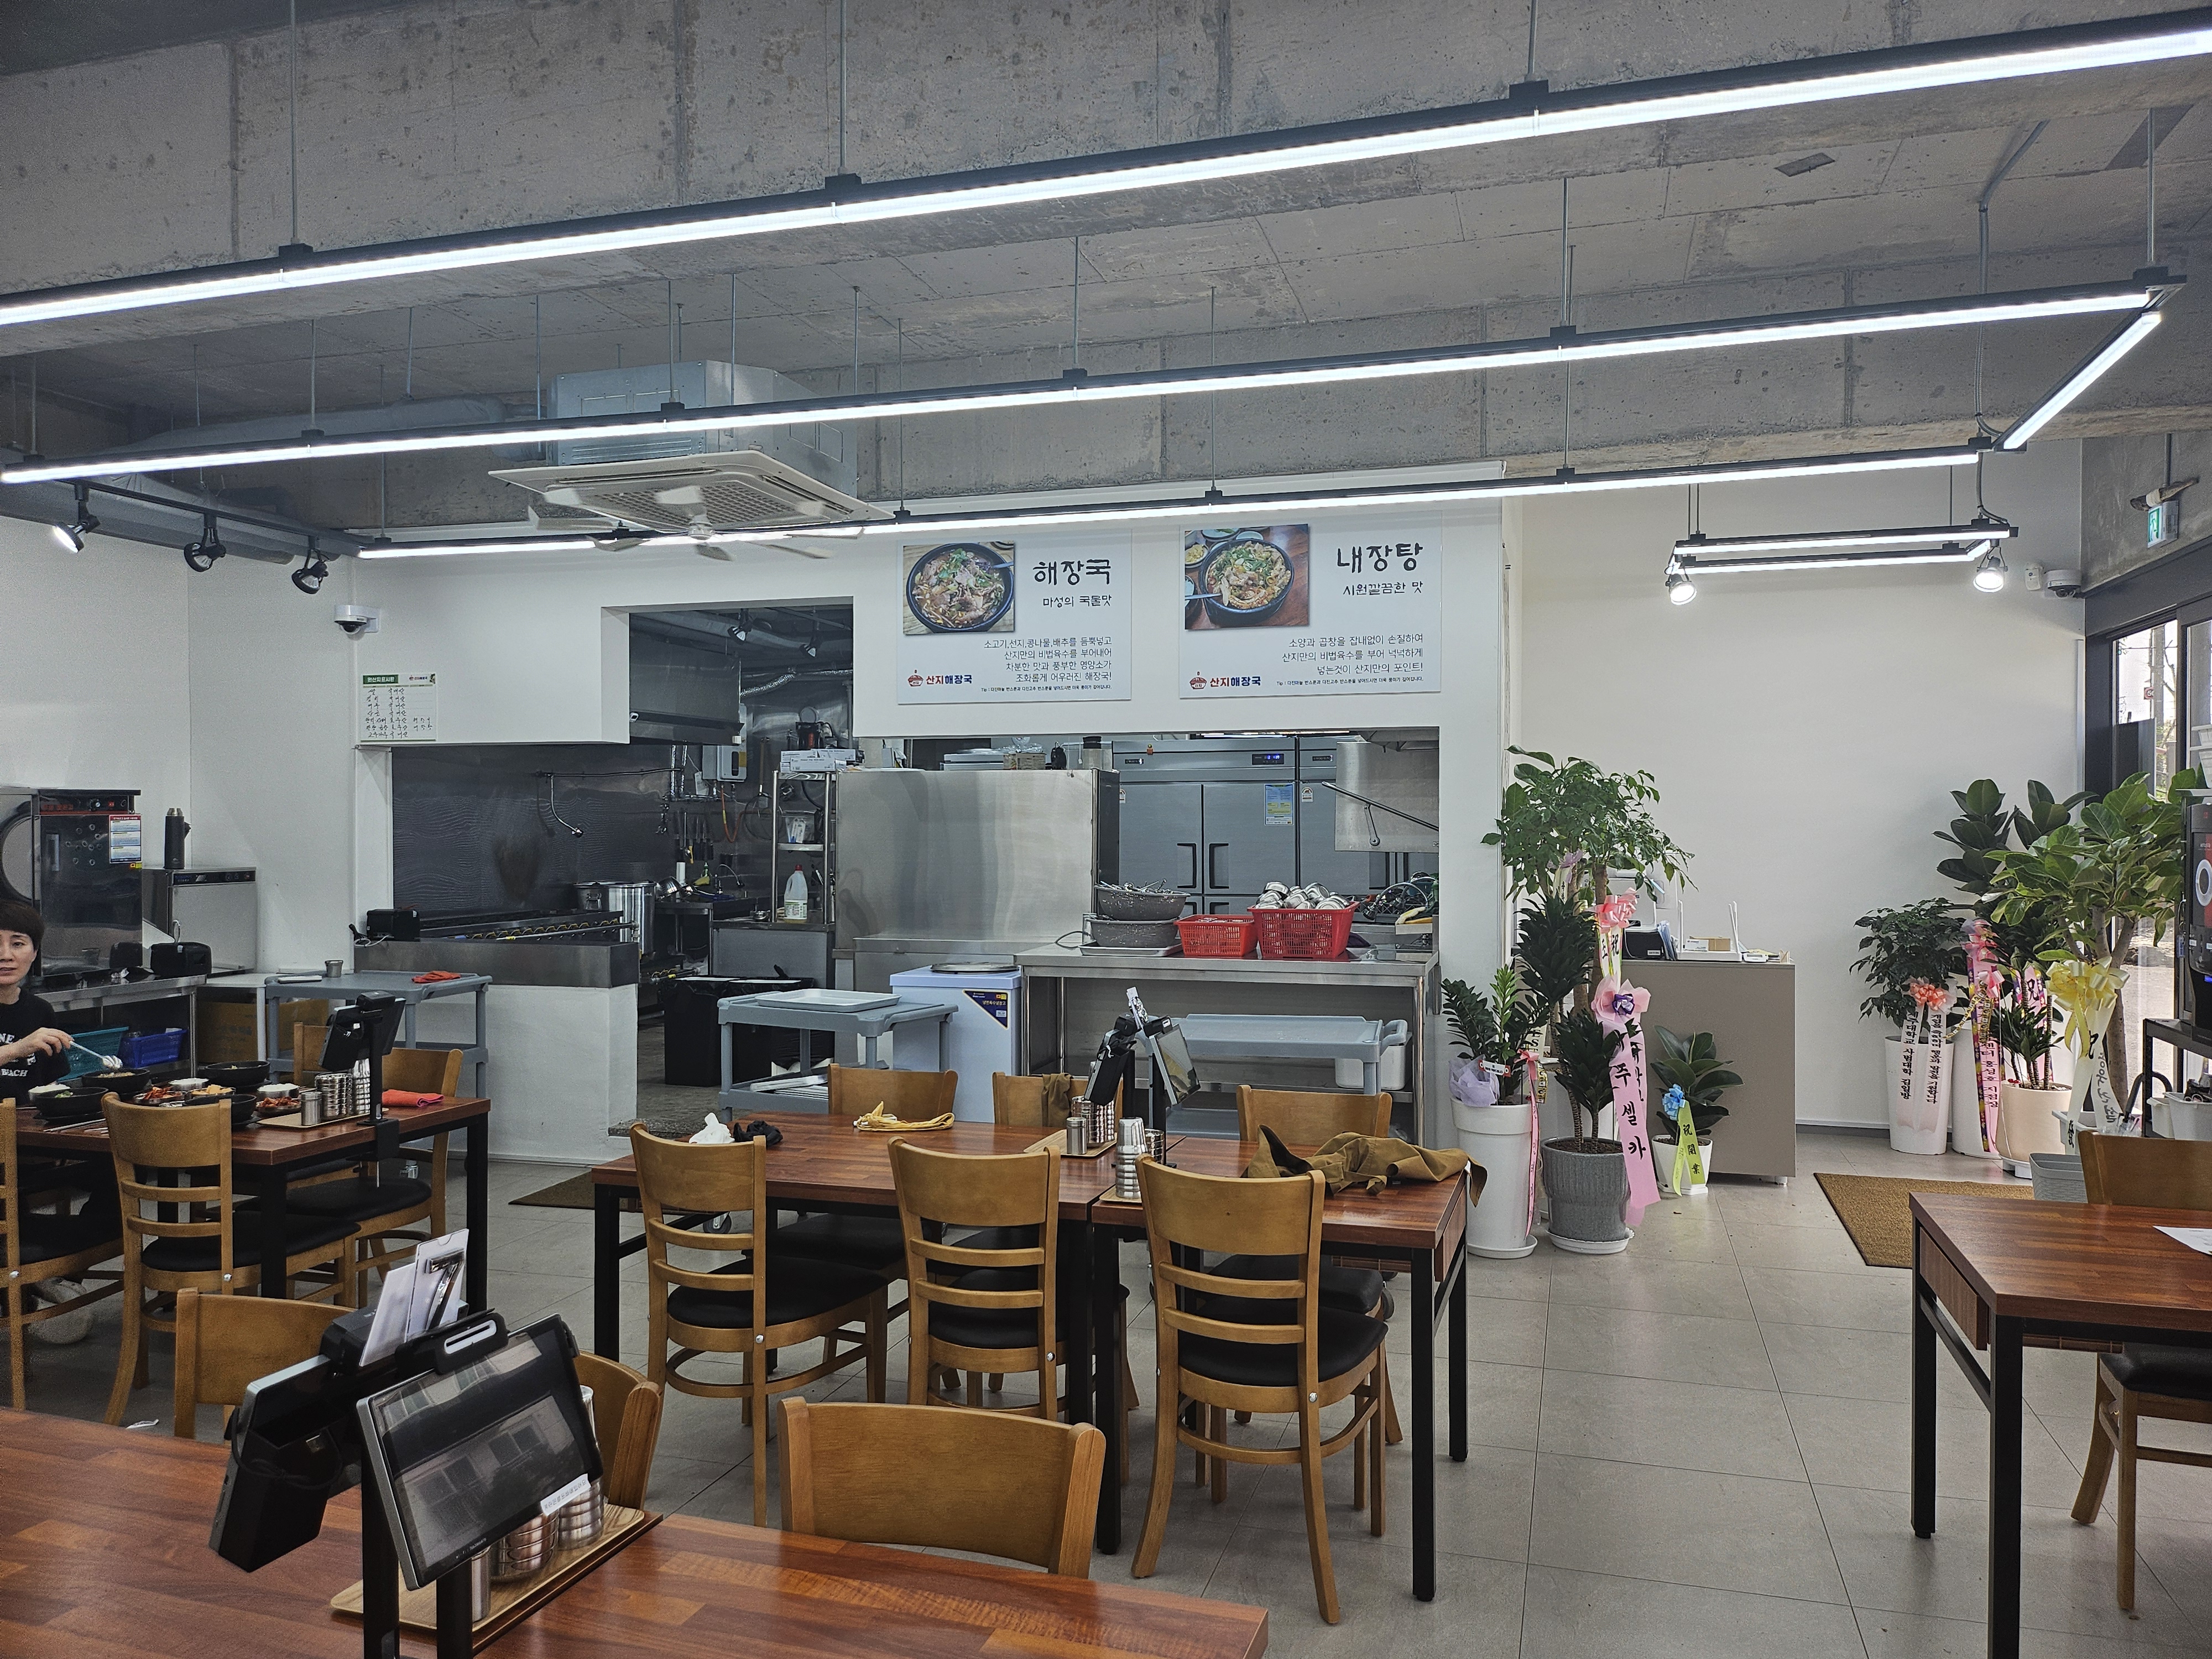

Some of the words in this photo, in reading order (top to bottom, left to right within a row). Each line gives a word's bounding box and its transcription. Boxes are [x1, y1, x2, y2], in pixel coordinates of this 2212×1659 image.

[1337, 542, 1423, 573] 내장탕
[1032, 559, 1112, 586] 해장국
[1343, 582, 1406, 596] 시원깔끔한
[1412, 581, 1423, 594] 맛
[1043, 596, 1074, 608] 마성의
[1079, 594, 1112, 607] 국물맛
[1288, 638, 1316, 648] 소양과
[1318, 637, 1346, 647] 곱창을
[1349, 635, 1384, 646] 잡내없이
[1387, 633, 1423, 644] 손질하여
[1004, 650, 1035, 660] 산지만의
[1039, 649, 1077, 659] 비법육수를
[1081, 648, 1112, 658] 부어내어
[1282, 651, 1316, 662] 산지만의
[1320, 650, 1364, 661] 비법육수를
[1367, 649, 1384, 660] 부어
[1388, 648, 1423, 659] 넉넉하게
[1006, 662, 1030, 672] 차분한
[1033, 661, 1049, 671] 맛과
[1052, 660, 1077, 671] 풍부한
[1080, 660, 1112, 670] 영양소가
[1317, 664, 1350, 676] 넣는것이
[1354, 663, 1390, 674] 산지만의
[1393, 662, 1423, 672] 포인트!
[926, 674, 973, 685] 산지해장국
[1015, 672, 1047, 683] 조화롭게
[1051, 672, 1082, 682] 어우러진
[1084, 671, 1112, 681] 해장국!
[1209, 676, 1261, 687] 산지해장국
[424, 1248, 465, 1331] 7
